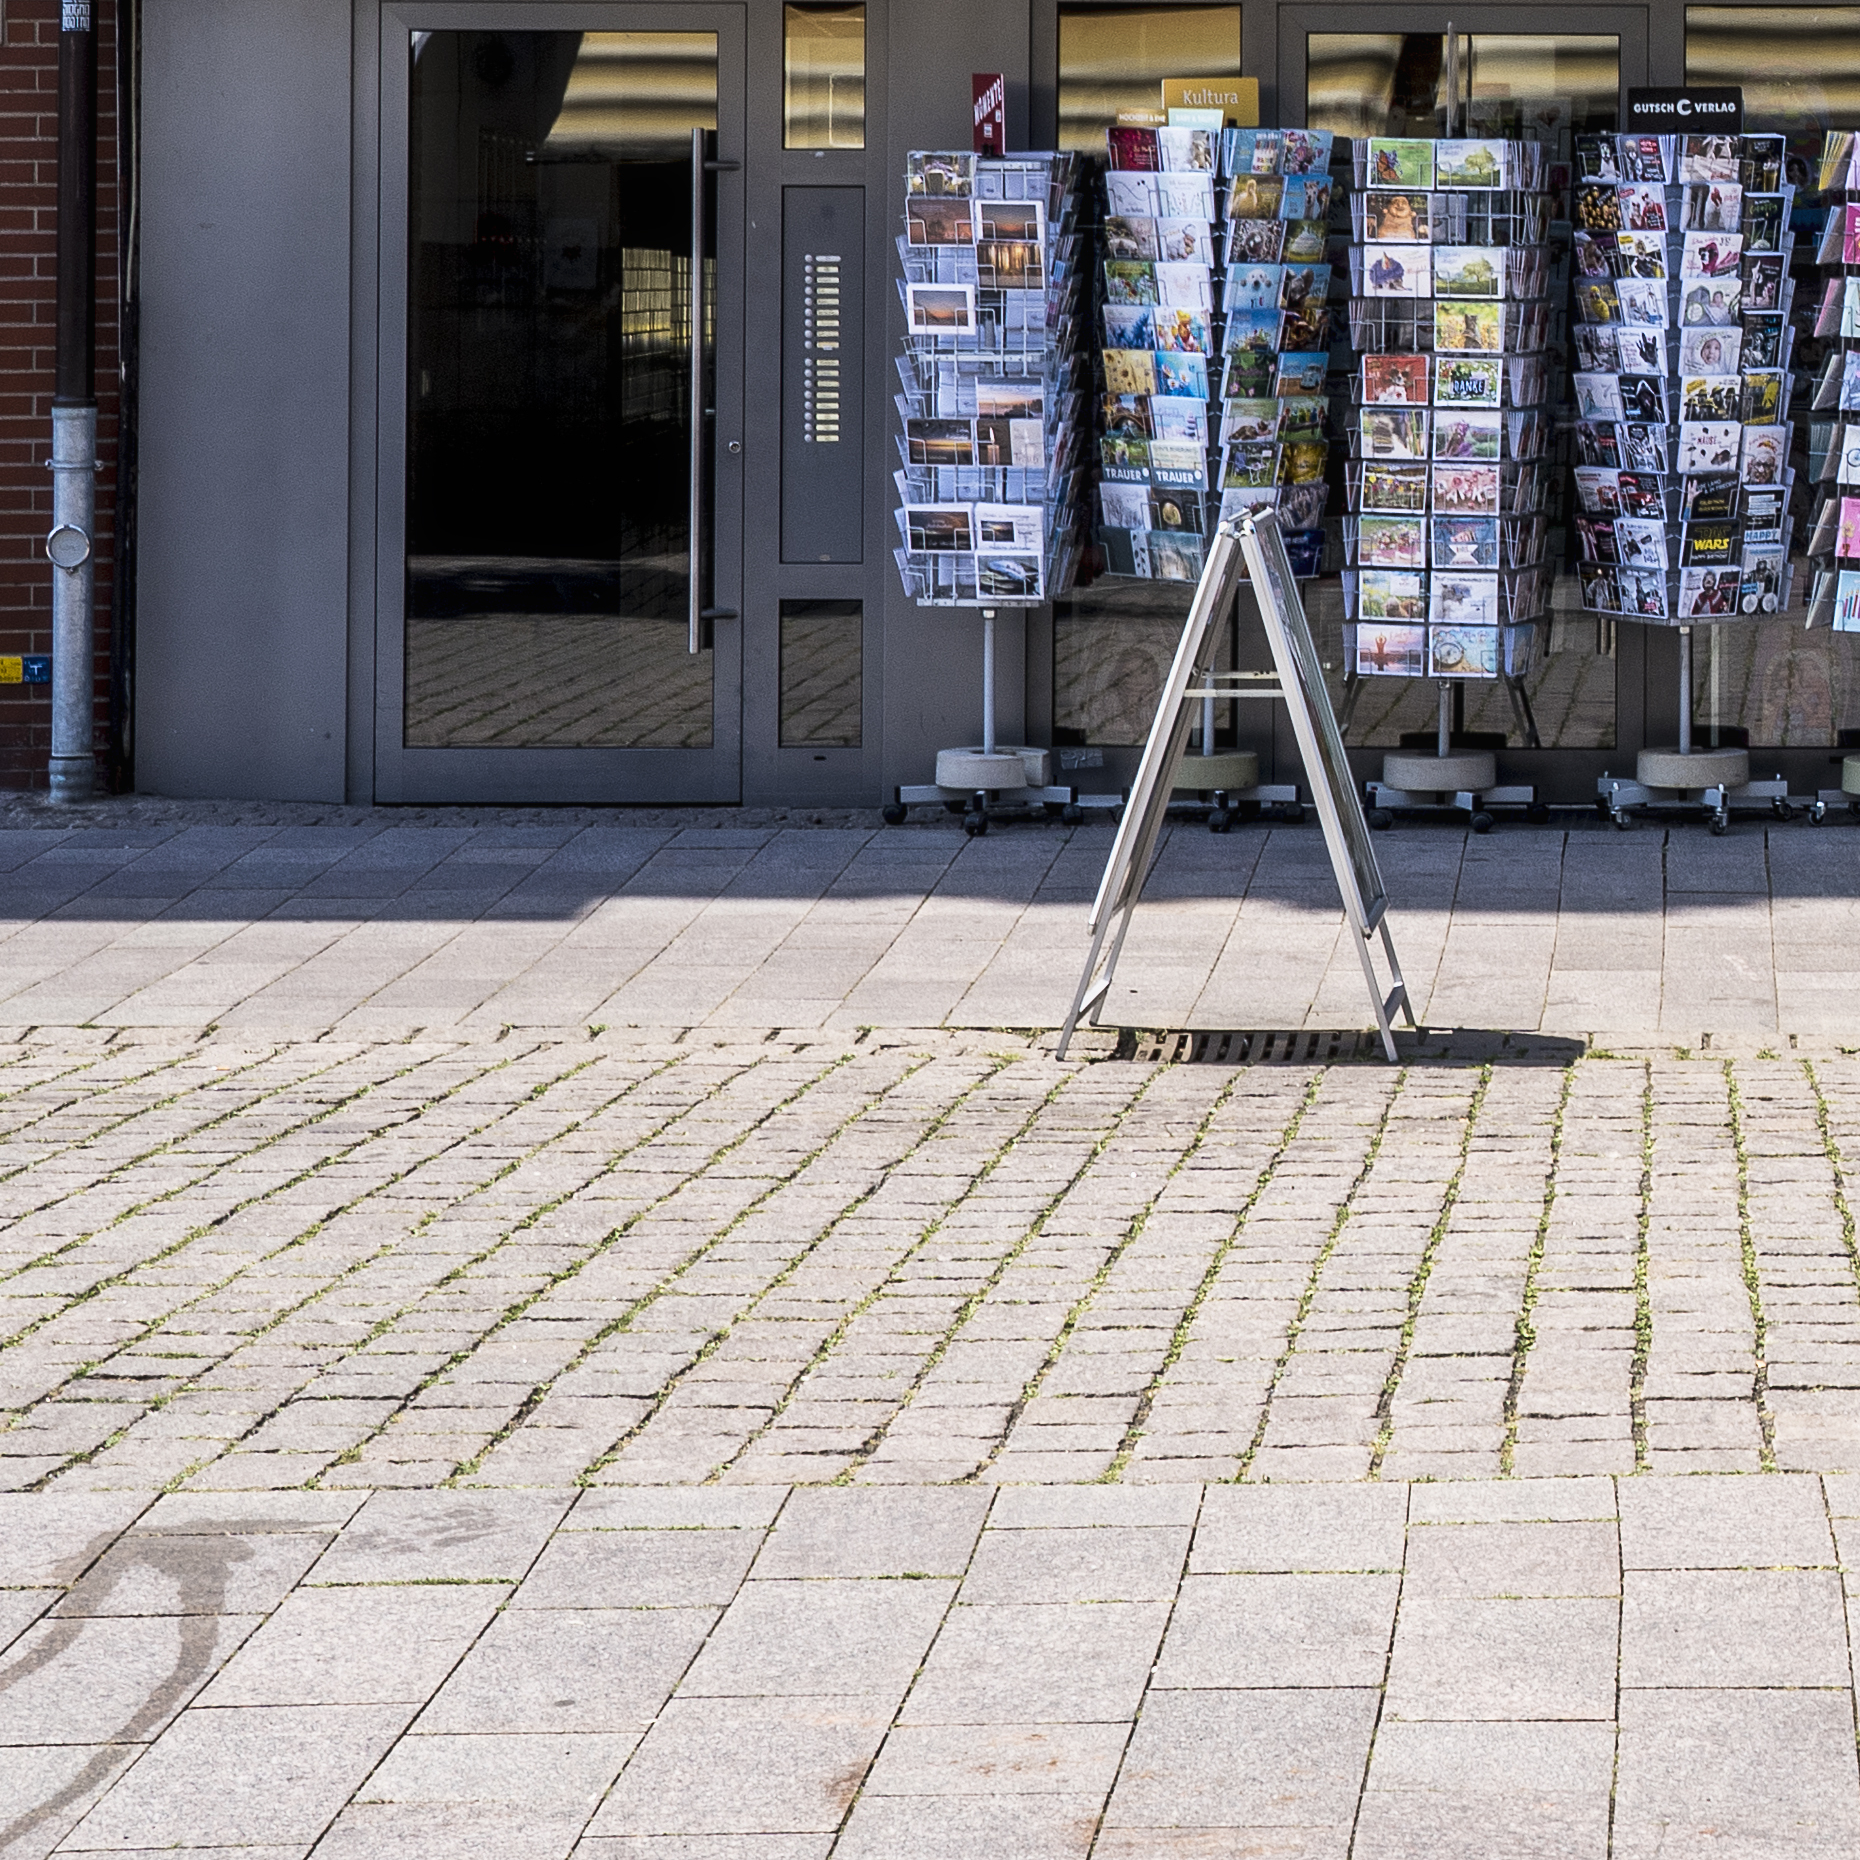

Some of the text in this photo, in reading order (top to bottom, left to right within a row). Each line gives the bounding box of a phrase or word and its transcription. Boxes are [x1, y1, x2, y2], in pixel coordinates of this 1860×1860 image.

[1183, 88, 1239, 105] Kultura
[1633, 103, 1736, 113] GUTSCH VERLAG
[1453, 379, 1484, 393] DANKE
[1104, 467, 1142, 482] TRAUER
[1155, 470, 1195, 484] TRAUER
[1745, 529, 1779, 541] HAPPY
[1693, 538, 1731, 551] WARS
